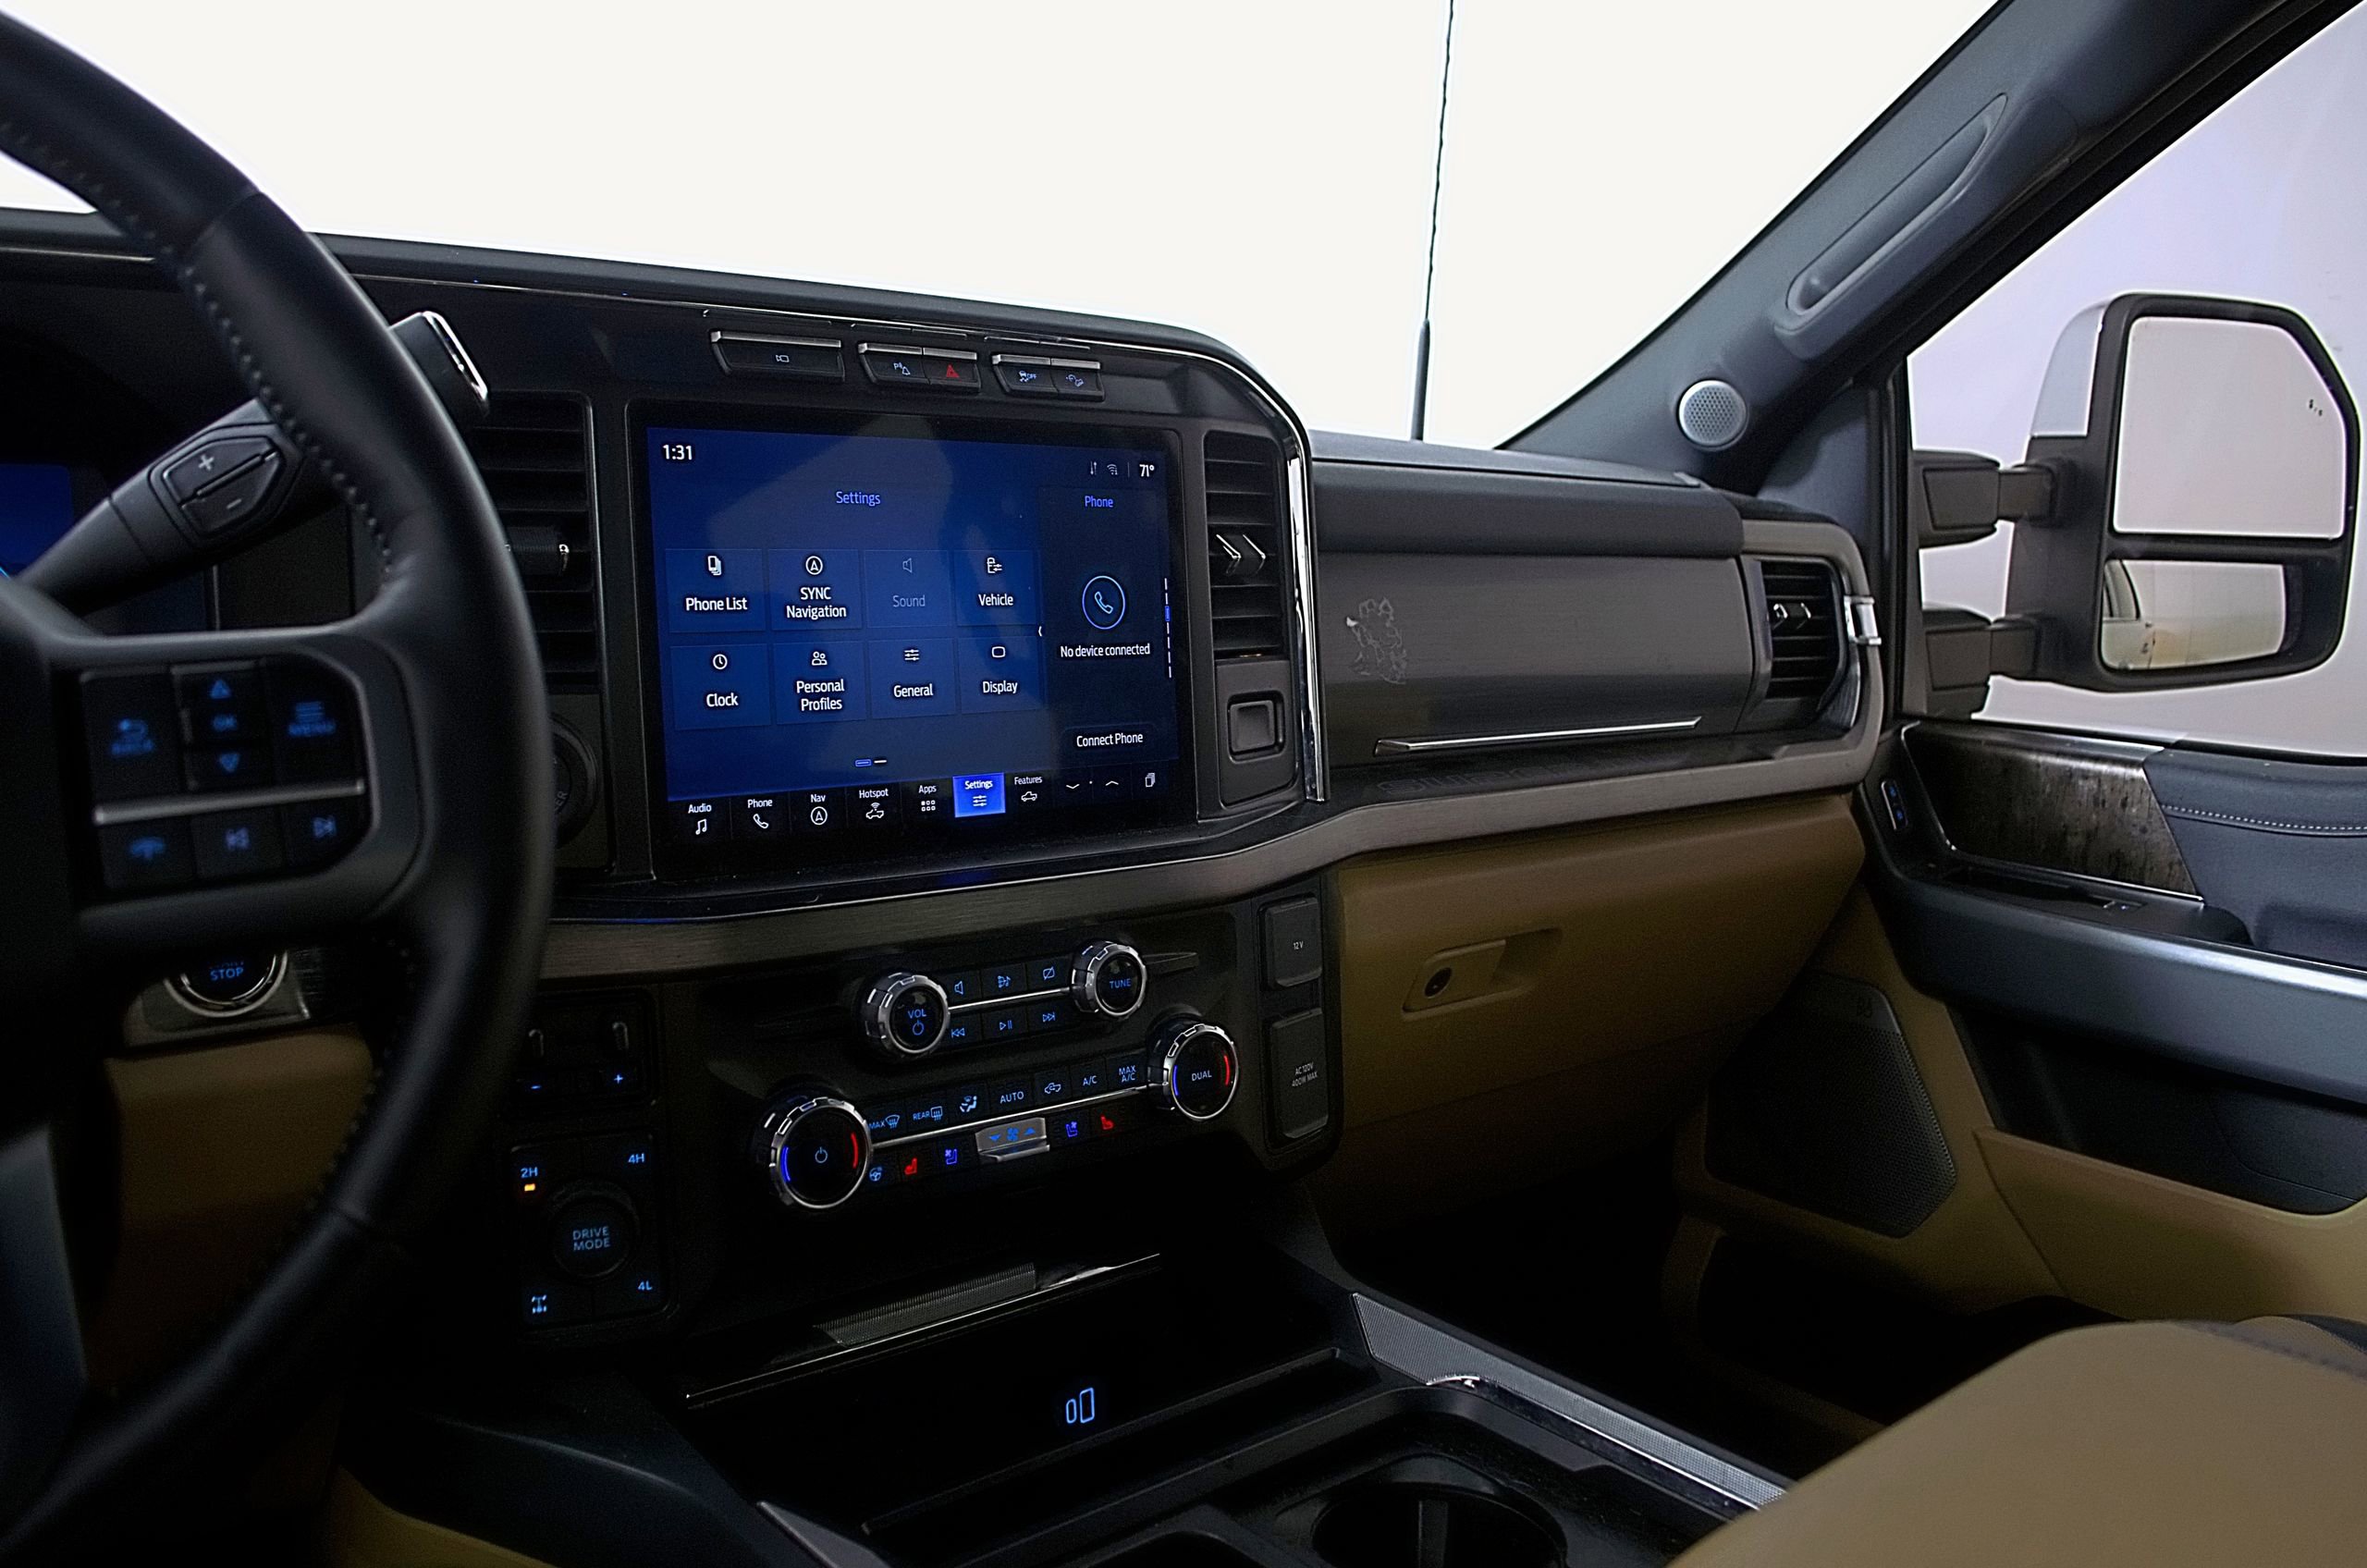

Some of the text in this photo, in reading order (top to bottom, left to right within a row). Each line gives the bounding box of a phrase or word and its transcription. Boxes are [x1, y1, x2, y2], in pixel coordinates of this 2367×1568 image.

[663, 445, 692, 459] 1:31
[837, 492, 880, 506] Settings
[1085, 496, 1113, 508] Phone
[801, 587, 831, 600] SYNC
[686, 597, 747, 610] Phone List
[893, 594, 925, 607] Sound
[978, 594, 1013, 606] Vehicle
[787, 605, 846, 619] Navigation
[1060, 643, 1151, 658] No device connected
[797, 679, 844, 693] Personal
[894, 683, 933, 697] General
[983, 680, 1018, 694] Display
[706, 692, 738, 706] Clock
[802, 697, 842, 711] Profiles
[1077, 733, 1143, 747] Connect Phone
[964, 778, 993, 791] Settings
[1014, 777, 1042, 785] Features
[859, 789, 889, 798] Hotspot
[919, 785, 937, 794] Apps
[748, 799, 772, 808] Phone
[811, 794, 826, 802] Nav
[688, 803, 711, 814] Audio
[211, 967, 243, 980] STOP
[1110, 979, 1131, 988] TUNE
[908, 1009, 926, 1019] VOL
[1119, 1065, 1135, 1077] MAX
[1121, 1071, 1135, 1082] A/C
[1192, 1071, 1211, 1081] DUAL
[1083, 1075, 1097, 1085] A/C
[1000, 1091, 1024, 1103] AUTO
[913, 1111, 930, 1121] REAR
[869, 1120, 886, 1130] MAX
[628, 1153, 645, 1164] 4H
[521, 1167, 538, 1178] 2H
[572, 1226, 610, 1240] DRIVE
[572, 1237, 611, 1251] MODE
[637, 1280, 653, 1292] 4L
